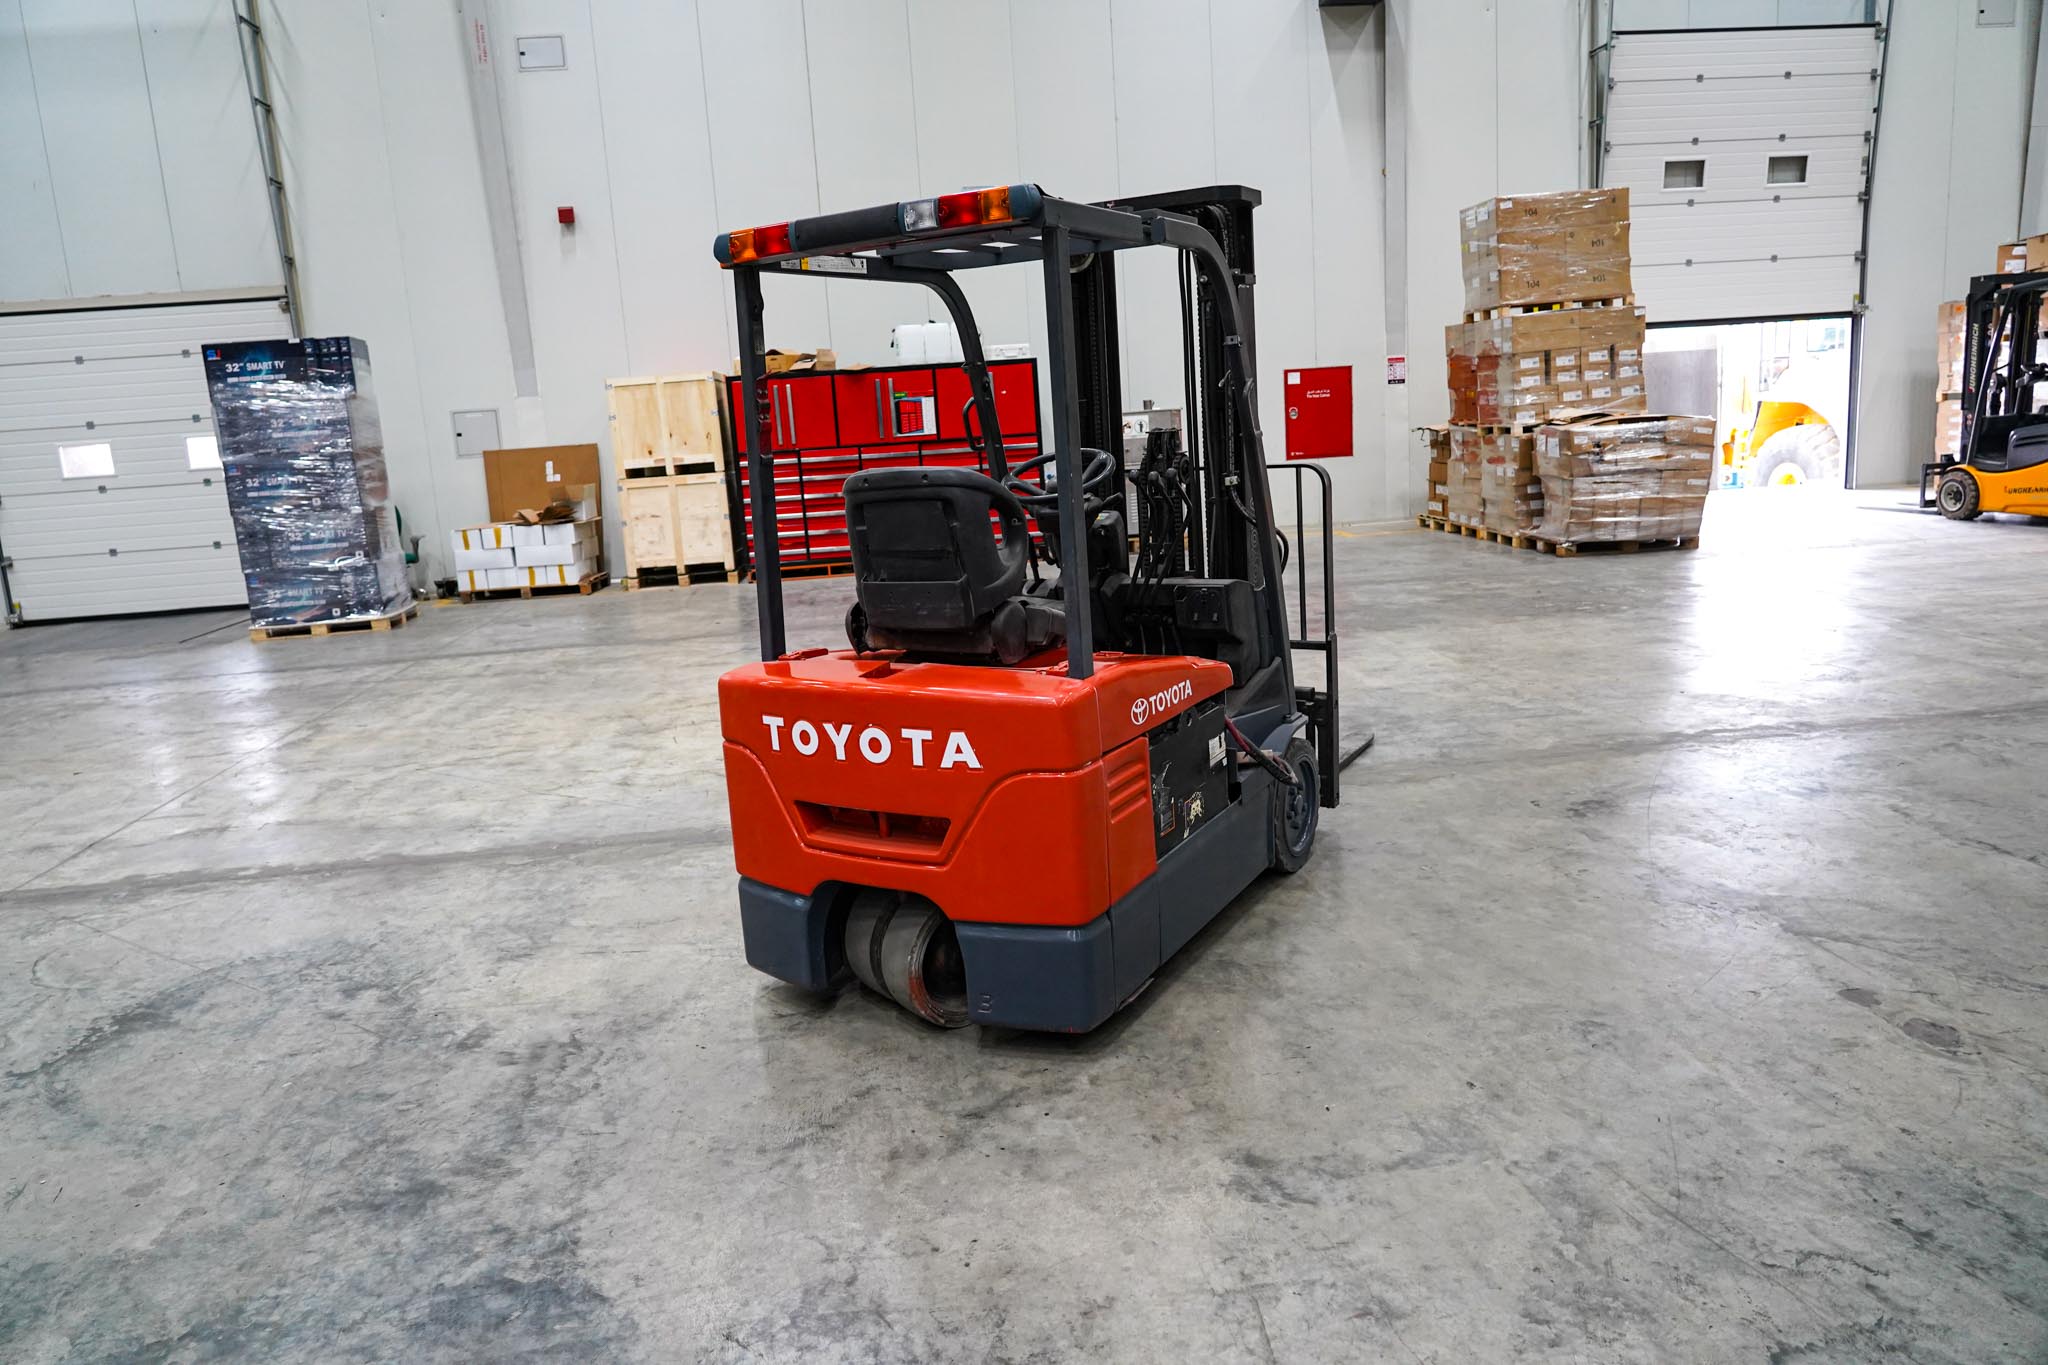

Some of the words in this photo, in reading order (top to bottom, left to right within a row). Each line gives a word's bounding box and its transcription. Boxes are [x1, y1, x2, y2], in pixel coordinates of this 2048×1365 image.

[1524, 208, 1538, 217] 104
[1526, 280, 1540, 288] 104
[1968, 323, 1980, 393] JUNGHEINRICH
[246, 360, 273, 371] SMART
[274, 360, 286, 369] TV
[337, 529, 347, 537] TV
[1149, 679, 1193, 715] TOYOTA
[761, 714, 982, 769] TOYOTA
